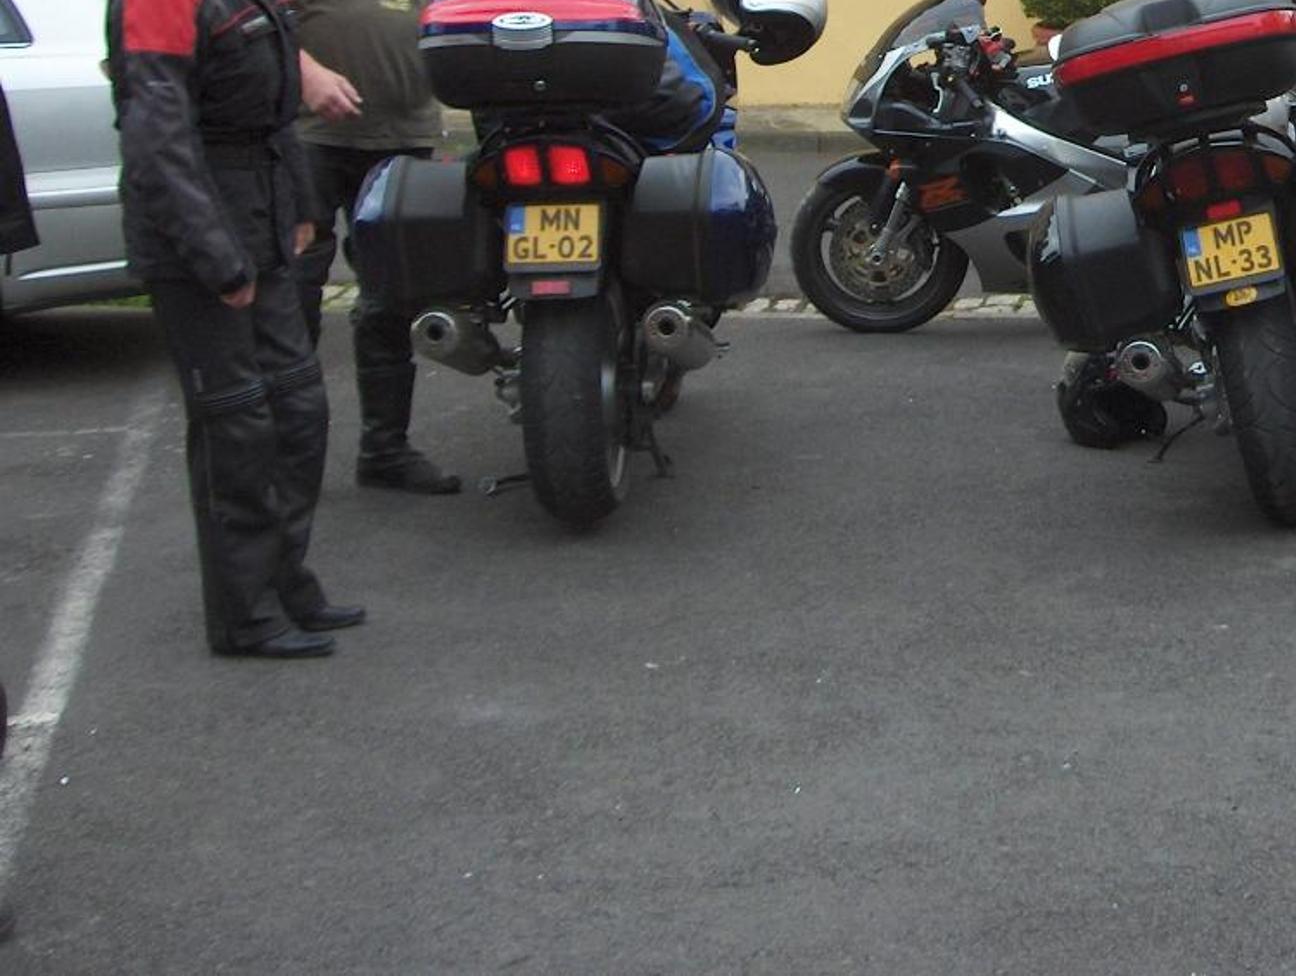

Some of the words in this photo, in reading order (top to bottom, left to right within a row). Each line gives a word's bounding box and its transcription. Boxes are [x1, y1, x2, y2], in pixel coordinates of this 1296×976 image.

[540, 207, 581, 231] MN
[512, 235, 594, 260] GL-02
[1213, 220, 1252, 250] MP
[1193, 245, 1273, 282] NL-33
